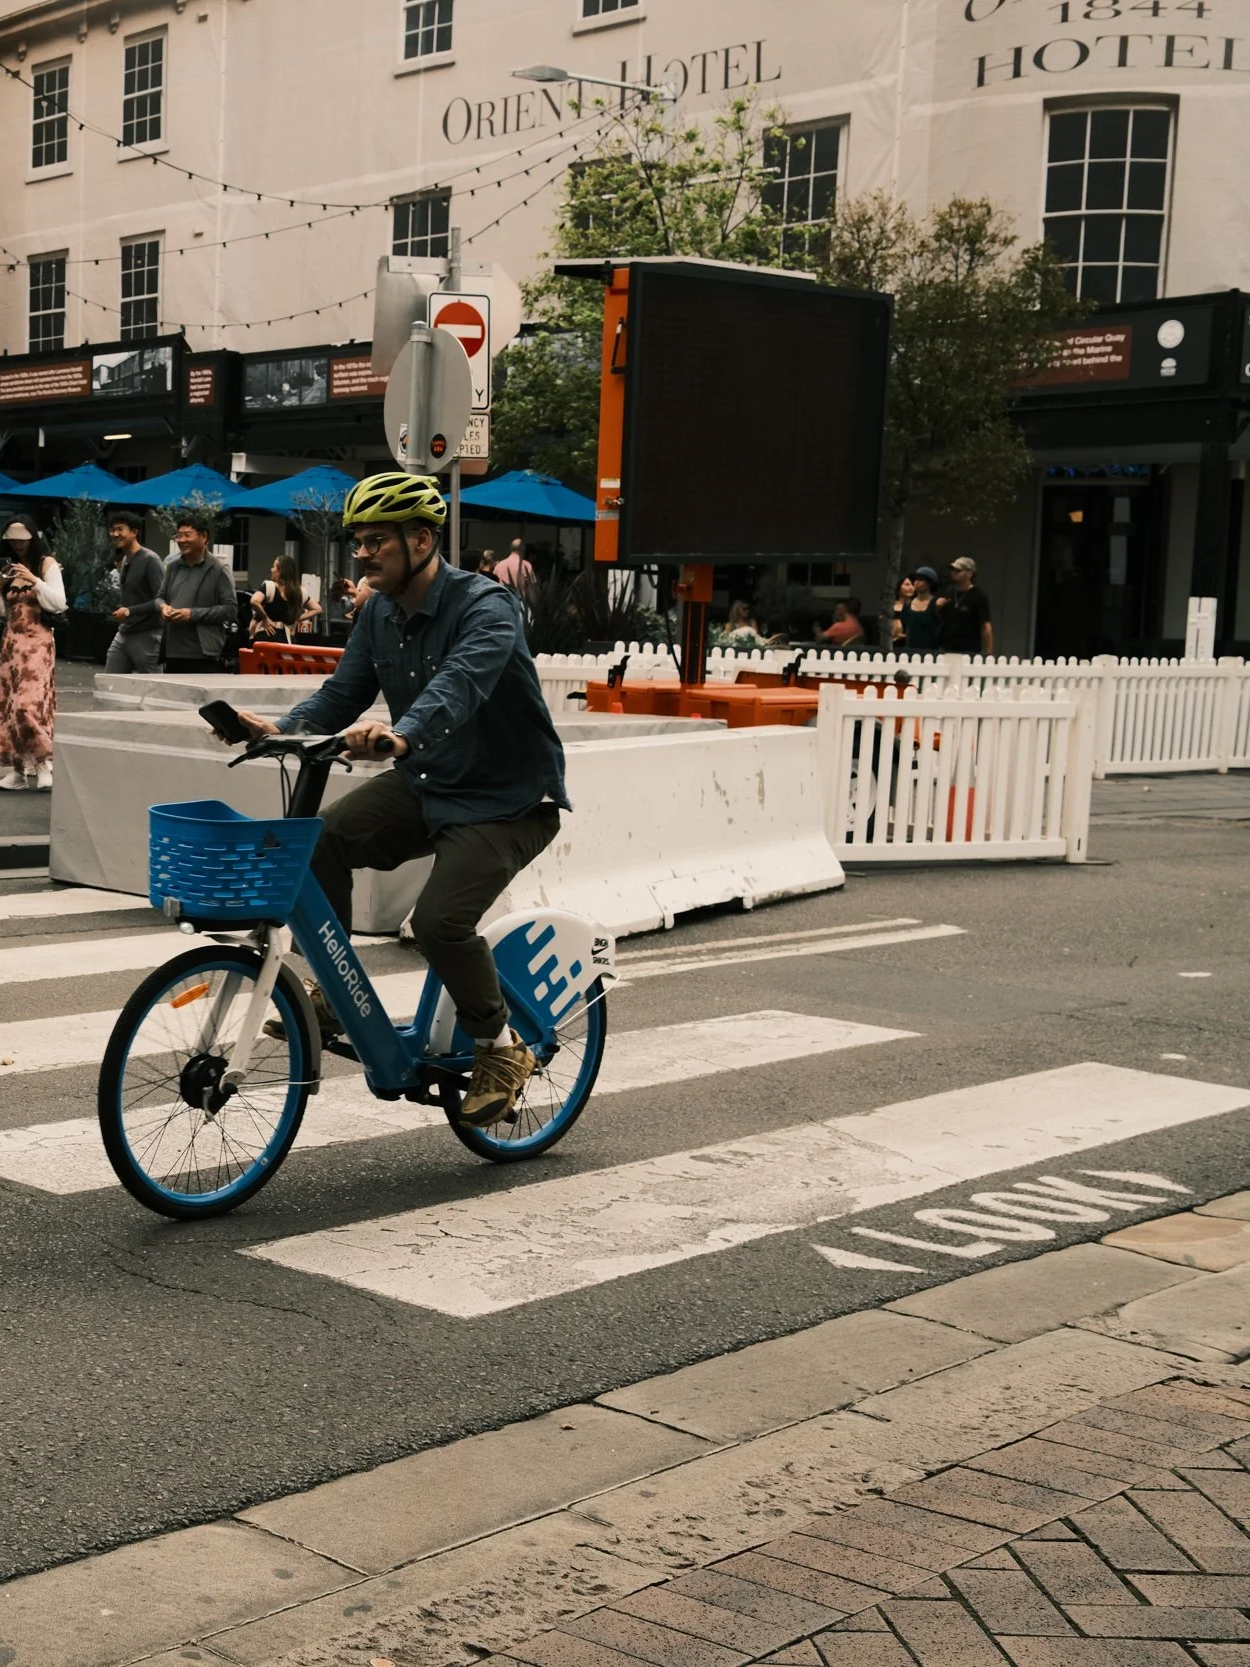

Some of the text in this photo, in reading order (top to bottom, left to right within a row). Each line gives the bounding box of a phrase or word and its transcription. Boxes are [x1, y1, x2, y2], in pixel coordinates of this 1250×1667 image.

[1047, 0, 1212, 24] 1844
[442, 39, 782, 145] ORIENT HOTEL
[971, 34, 1250, 91] HOTEL
[1105, 333, 1126, 343] Quay
[318, 920, 371, 1018] HelloRide
[851, 1175, 1170, 1259] LOOK
